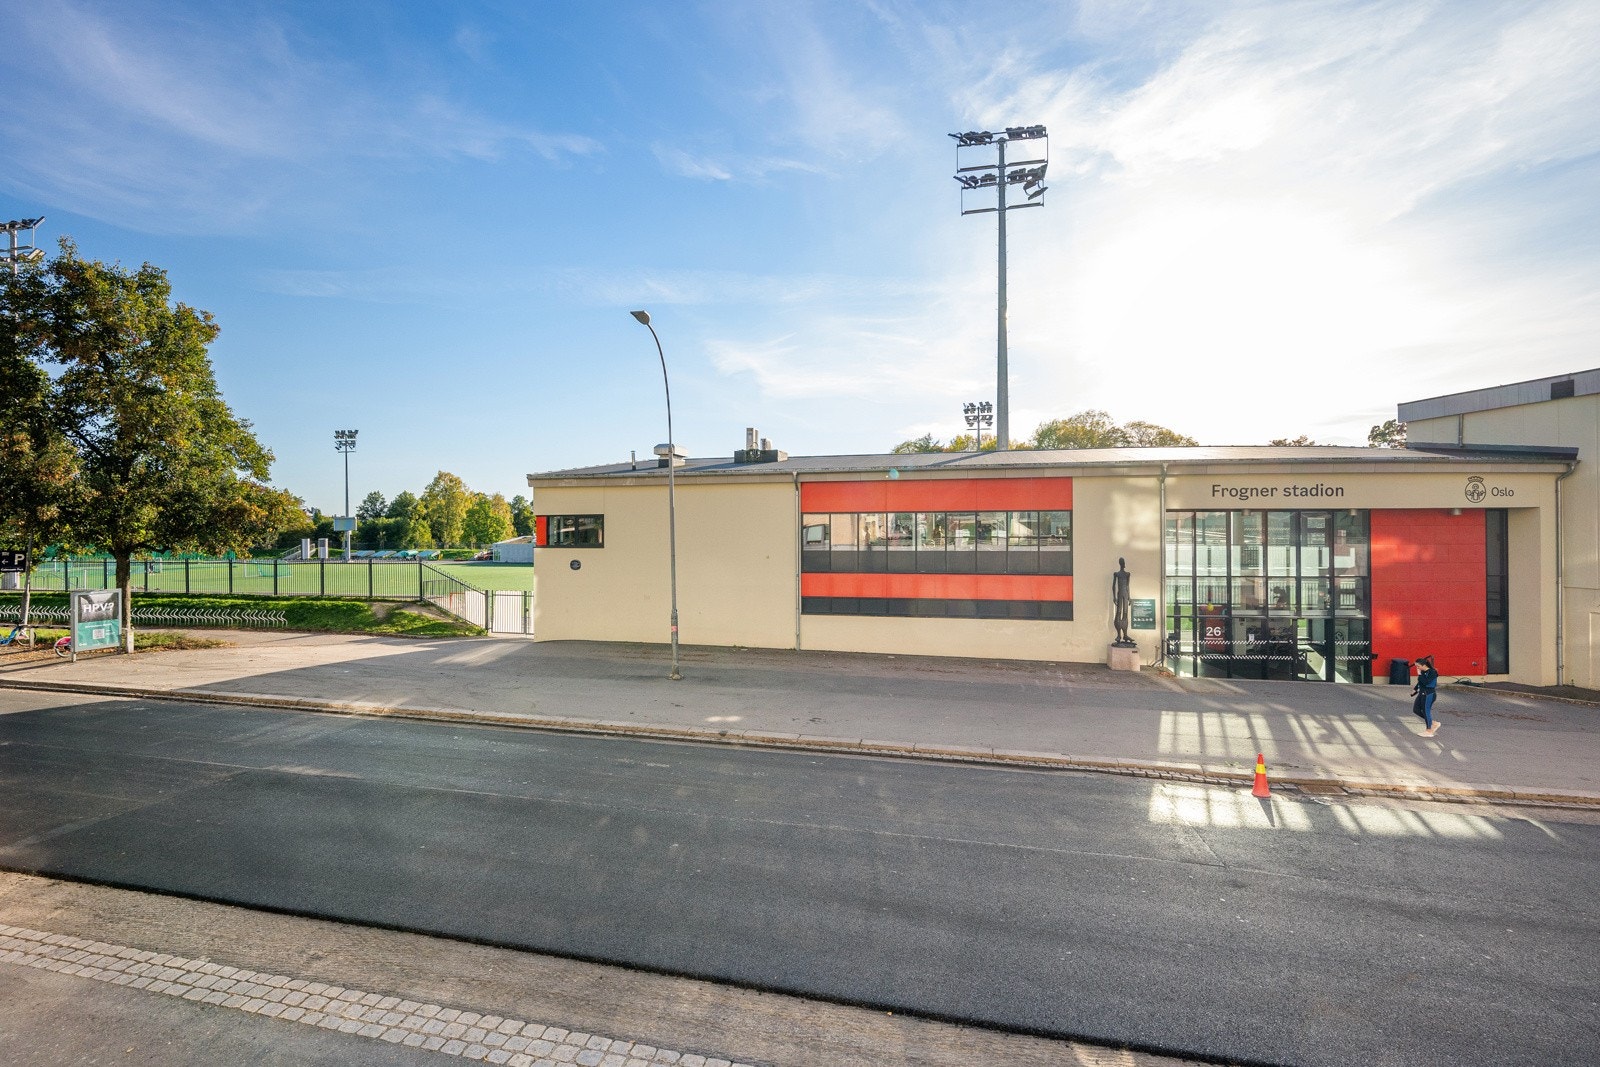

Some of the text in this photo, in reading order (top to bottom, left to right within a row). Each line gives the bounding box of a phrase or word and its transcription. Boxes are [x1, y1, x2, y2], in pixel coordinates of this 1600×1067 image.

[1212, 484, 1344, 500] Frogner stadion
[1491, 487, 1514, 497] Oslo
[14, 553, 25, 565] P
[83, 603, 115, 613] HPV?
[1206, 626, 1221, 637] 26
